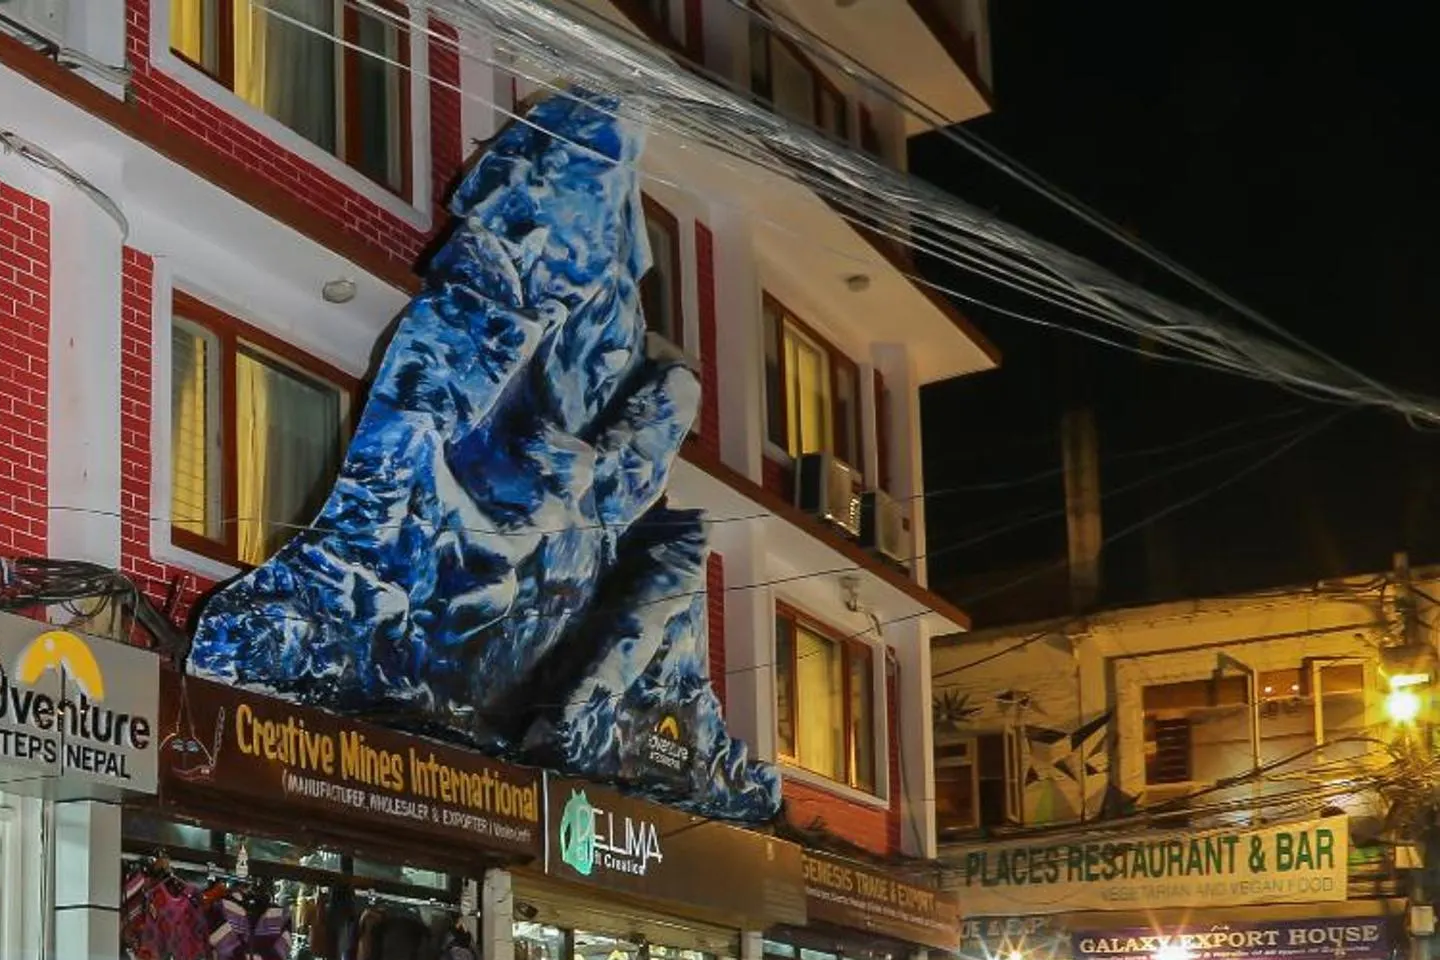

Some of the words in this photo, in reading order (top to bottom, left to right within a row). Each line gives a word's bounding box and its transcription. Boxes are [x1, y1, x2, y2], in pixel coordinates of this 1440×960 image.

[66, 744, 132, 780] NEPAL
[235, 703, 334, 775] Creative
[340, 730, 405, 793] Mines
[410, 747, 538, 823] International
[965, 847, 1060, 888] PLACES
[1066, 835, 1240, 884] RESTAURANT
[1247, 836, 1267, 874] &
[1275, 828, 1335, 873] BAR
[1079, 933, 1171, 954] GALAXY
[1179, 929, 1281, 950] EXPORT
[1288, 924, 1380, 947] HOUSE
